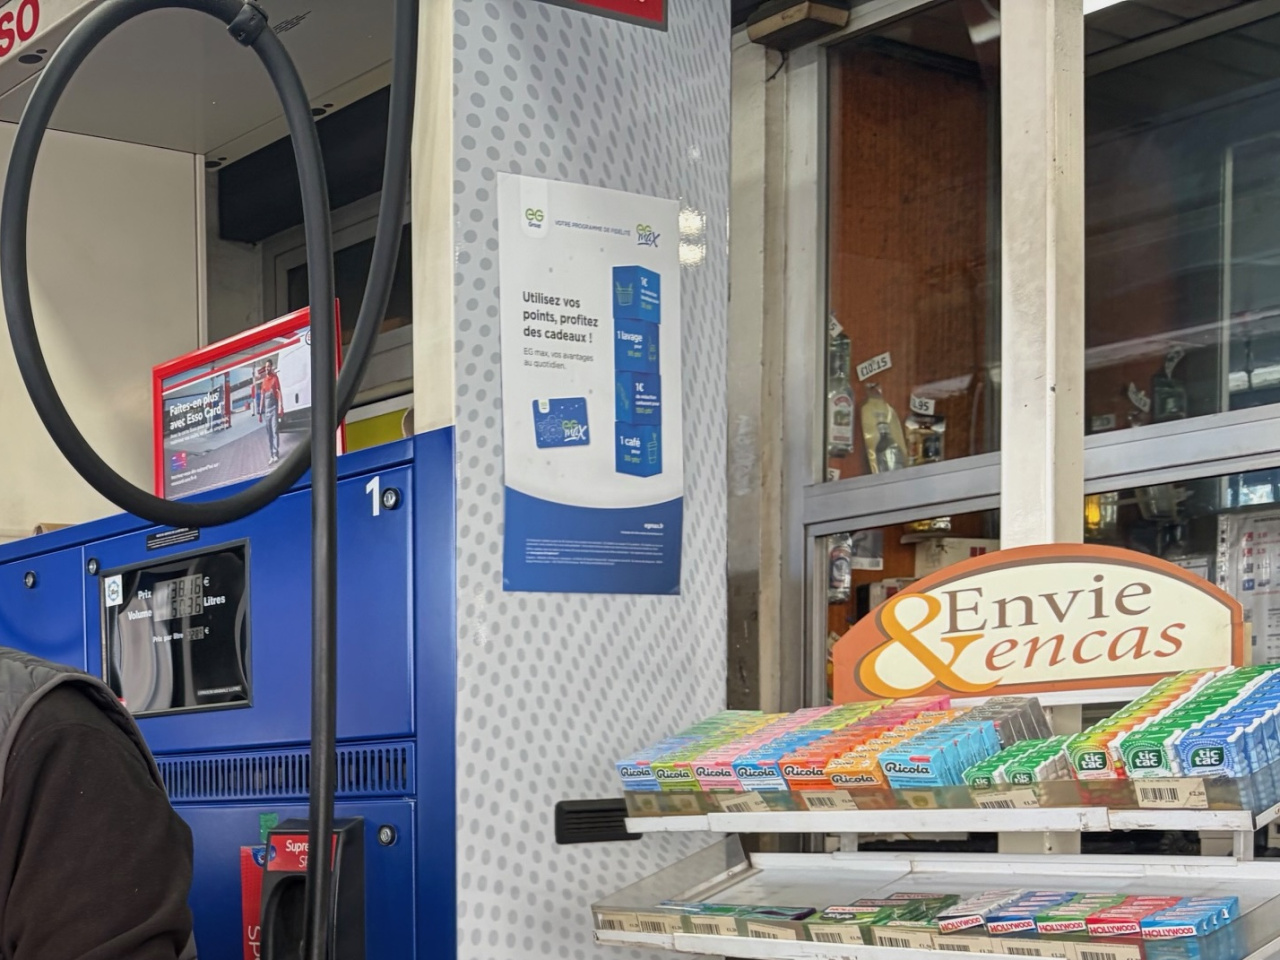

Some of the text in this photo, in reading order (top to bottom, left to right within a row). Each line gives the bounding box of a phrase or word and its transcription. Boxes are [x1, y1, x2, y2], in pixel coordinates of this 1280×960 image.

[523, 291, 580, 309] Utilisez vos
[523, 309, 598, 327] points, profitez
[524, 326, 542, 338] des
[545, 329, 586, 342] cadeaux
[523, 347, 533, 355] EG
[170, 391, 219, 417] Faites-en plus
[170, 402, 221, 430] avec Esso Card
[366, 476, 379, 516] 1
[138, 589, 152, 599] Prix
[203, 577, 210, 586] €
[127, 609, 152, 620] Volume
[204, 596, 225, 606] Litres
[941, 574, 1153, 635] Envie
[860, 593, 1003, 699] &
[985, 622, 1186, 672] encas
[1084, 753, 1101, 763] tic
[1138, 751, 1158, 761] tic
[1199, 749, 1220, 759] tic
[1081, 760, 1103, 769] tac
[1135, 759, 1158, 767] tac
[1195, 757, 1220, 766] tac
[620, 767, 651, 777] Ricola
[696, 766, 732, 777] Ricola
[738, 767, 775, 777] Ricola
[784, 765, 824, 776] Ricola
[885, 762, 930, 774] Ricola
[656, 769, 690, 779] Ricola
[832, 775, 874, 784] Ricola
[286, 839, 308, 855] Supre
[941, 918, 980, 933] HOLLYWOOD
[990, 921, 1033, 933] HOLLYWOOD
[1039, 922, 1084, 933] HOLLYWOOD
[1090, 924, 1137, 935] HOLLYWOOD
[1143, 927, 1194, 937] HOLLYWOOD
